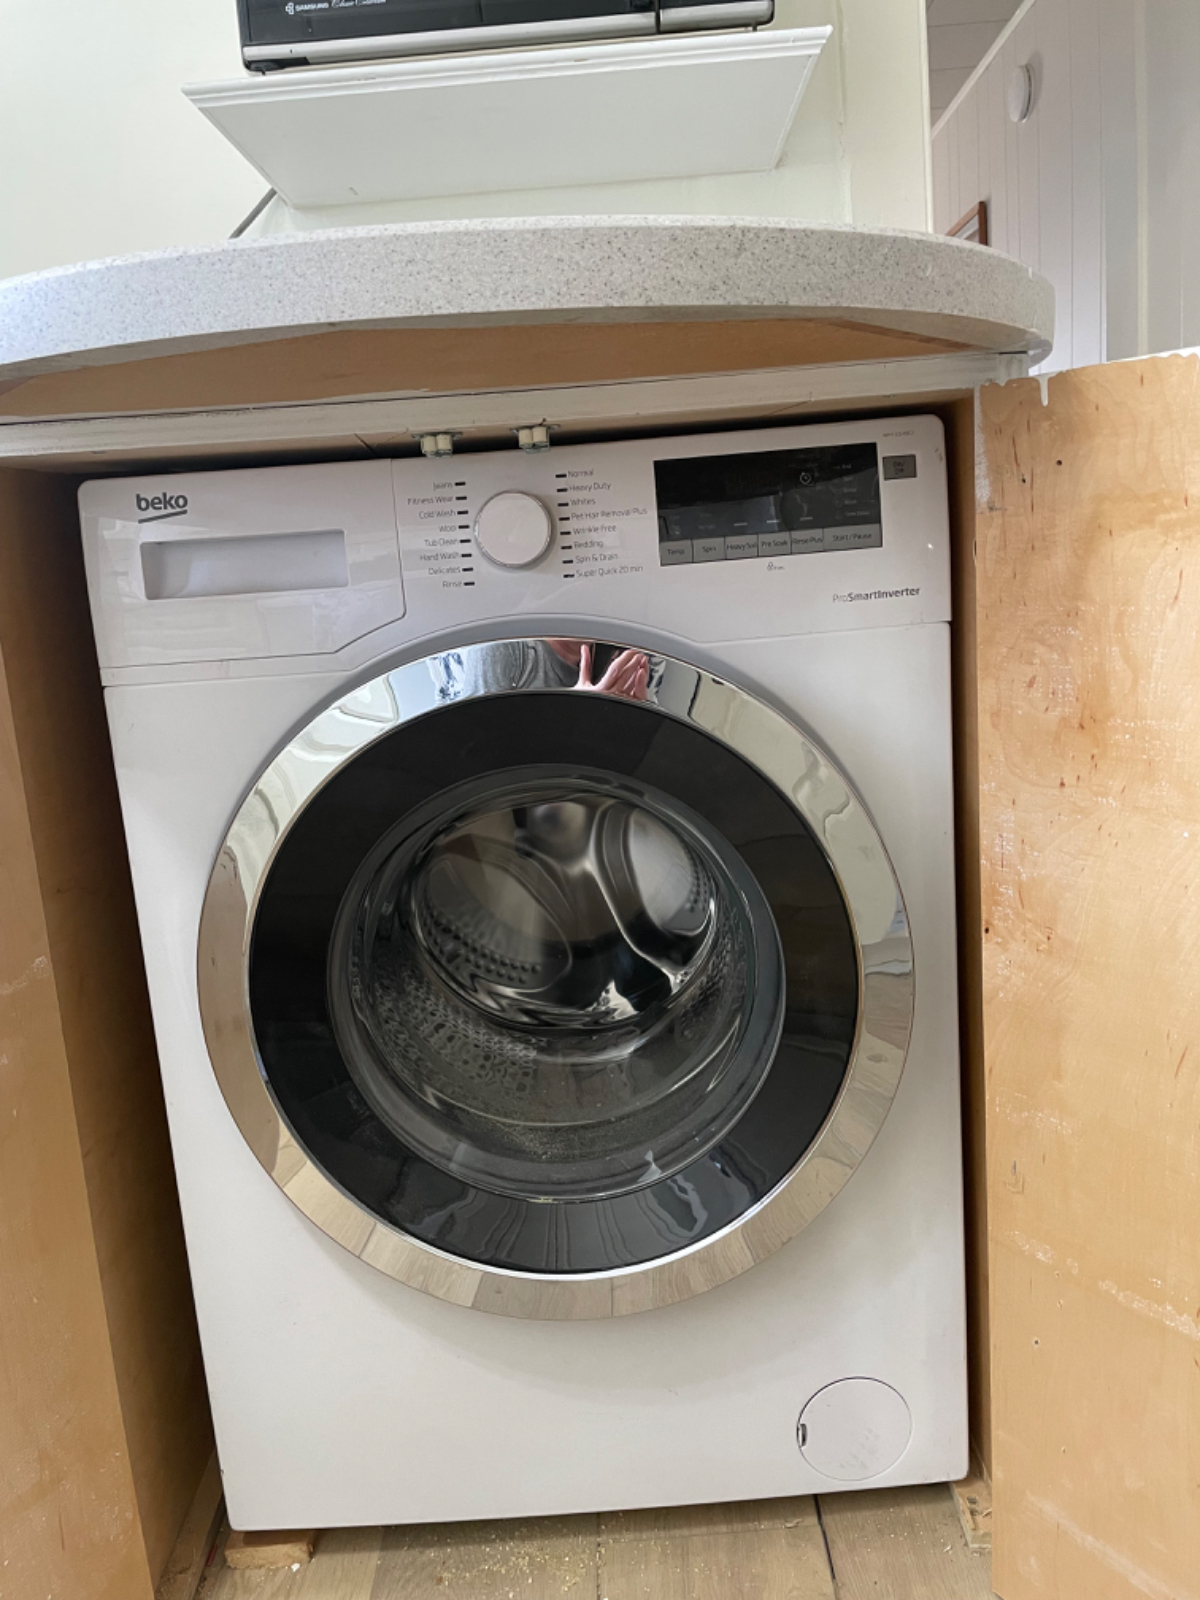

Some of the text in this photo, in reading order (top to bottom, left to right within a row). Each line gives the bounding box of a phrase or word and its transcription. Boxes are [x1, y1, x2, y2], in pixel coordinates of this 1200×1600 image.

[295, 3, 329, 11] SAMSUNG
[568, 469, 594, 478] Normal
[569, 482, 611, 492] Heavy Duty
[136, 491, 188, 511] beko
[407, 496, 454, 505] Fitness Wear
[570, 498, 596, 506] Whites
[419, 509, 456, 519] Cold Wash
[571, 512, 585, 520] Pet
[585, 511, 599, 519] Hair
[632, 507, 648, 515] Plus
[573, 524, 617, 535] Wrinkle Free
[424, 539, 437, 547] Tub
[420, 553, 439, 561] Hand
[575, 554, 591, 564] Spin
[599, 553, 618, 561] Drain
[428, 566, 461, 575] Delicates
[575, 569, 597, 578] Super
[598, 567, 618, 575] Quick
[629, 565, 643, 573] min
[832, 587, 920, 603] ProSmartInverter
